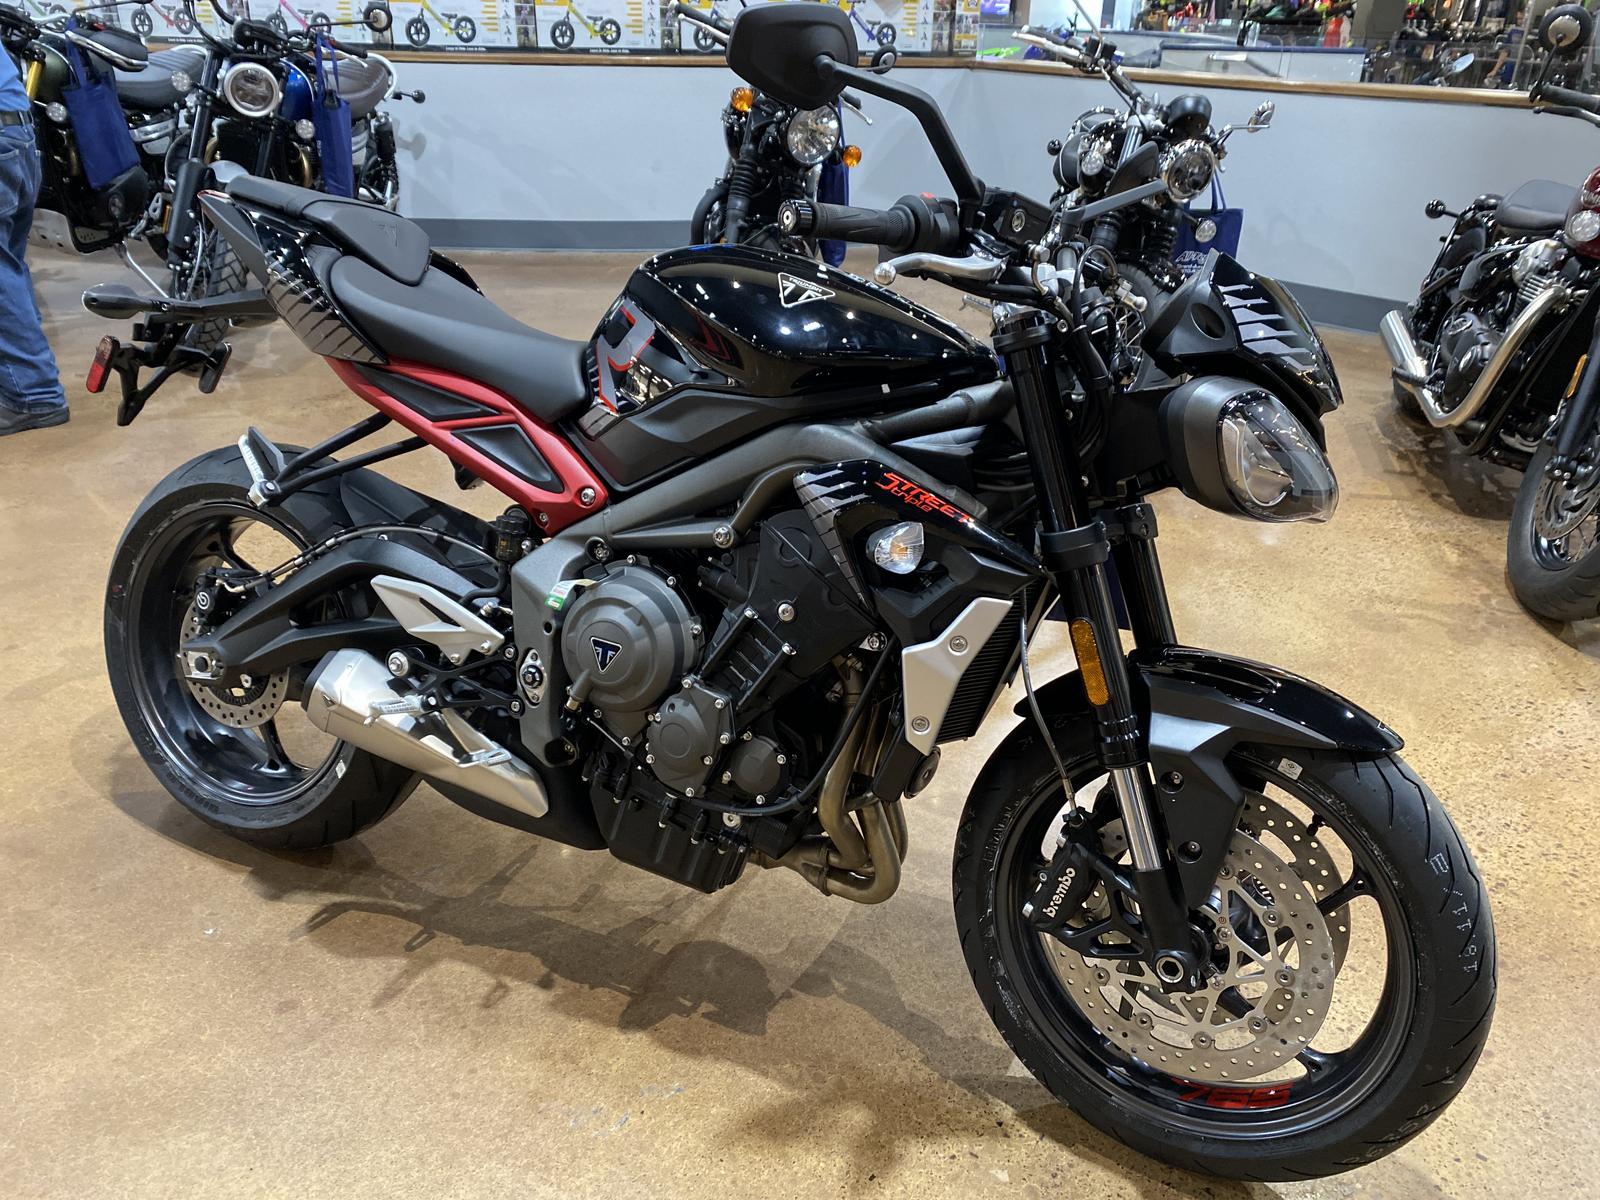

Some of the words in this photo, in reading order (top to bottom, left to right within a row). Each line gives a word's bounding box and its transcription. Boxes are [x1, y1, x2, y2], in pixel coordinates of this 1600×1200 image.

[789, 277, 823, 292] TRIUMPH
[874, 472, 976, 523] STREET
[891, 487, 933, 512] triple
[1042, 867, 1076, 918] brembo
[1170, 1076, 1294, 1109] 765
